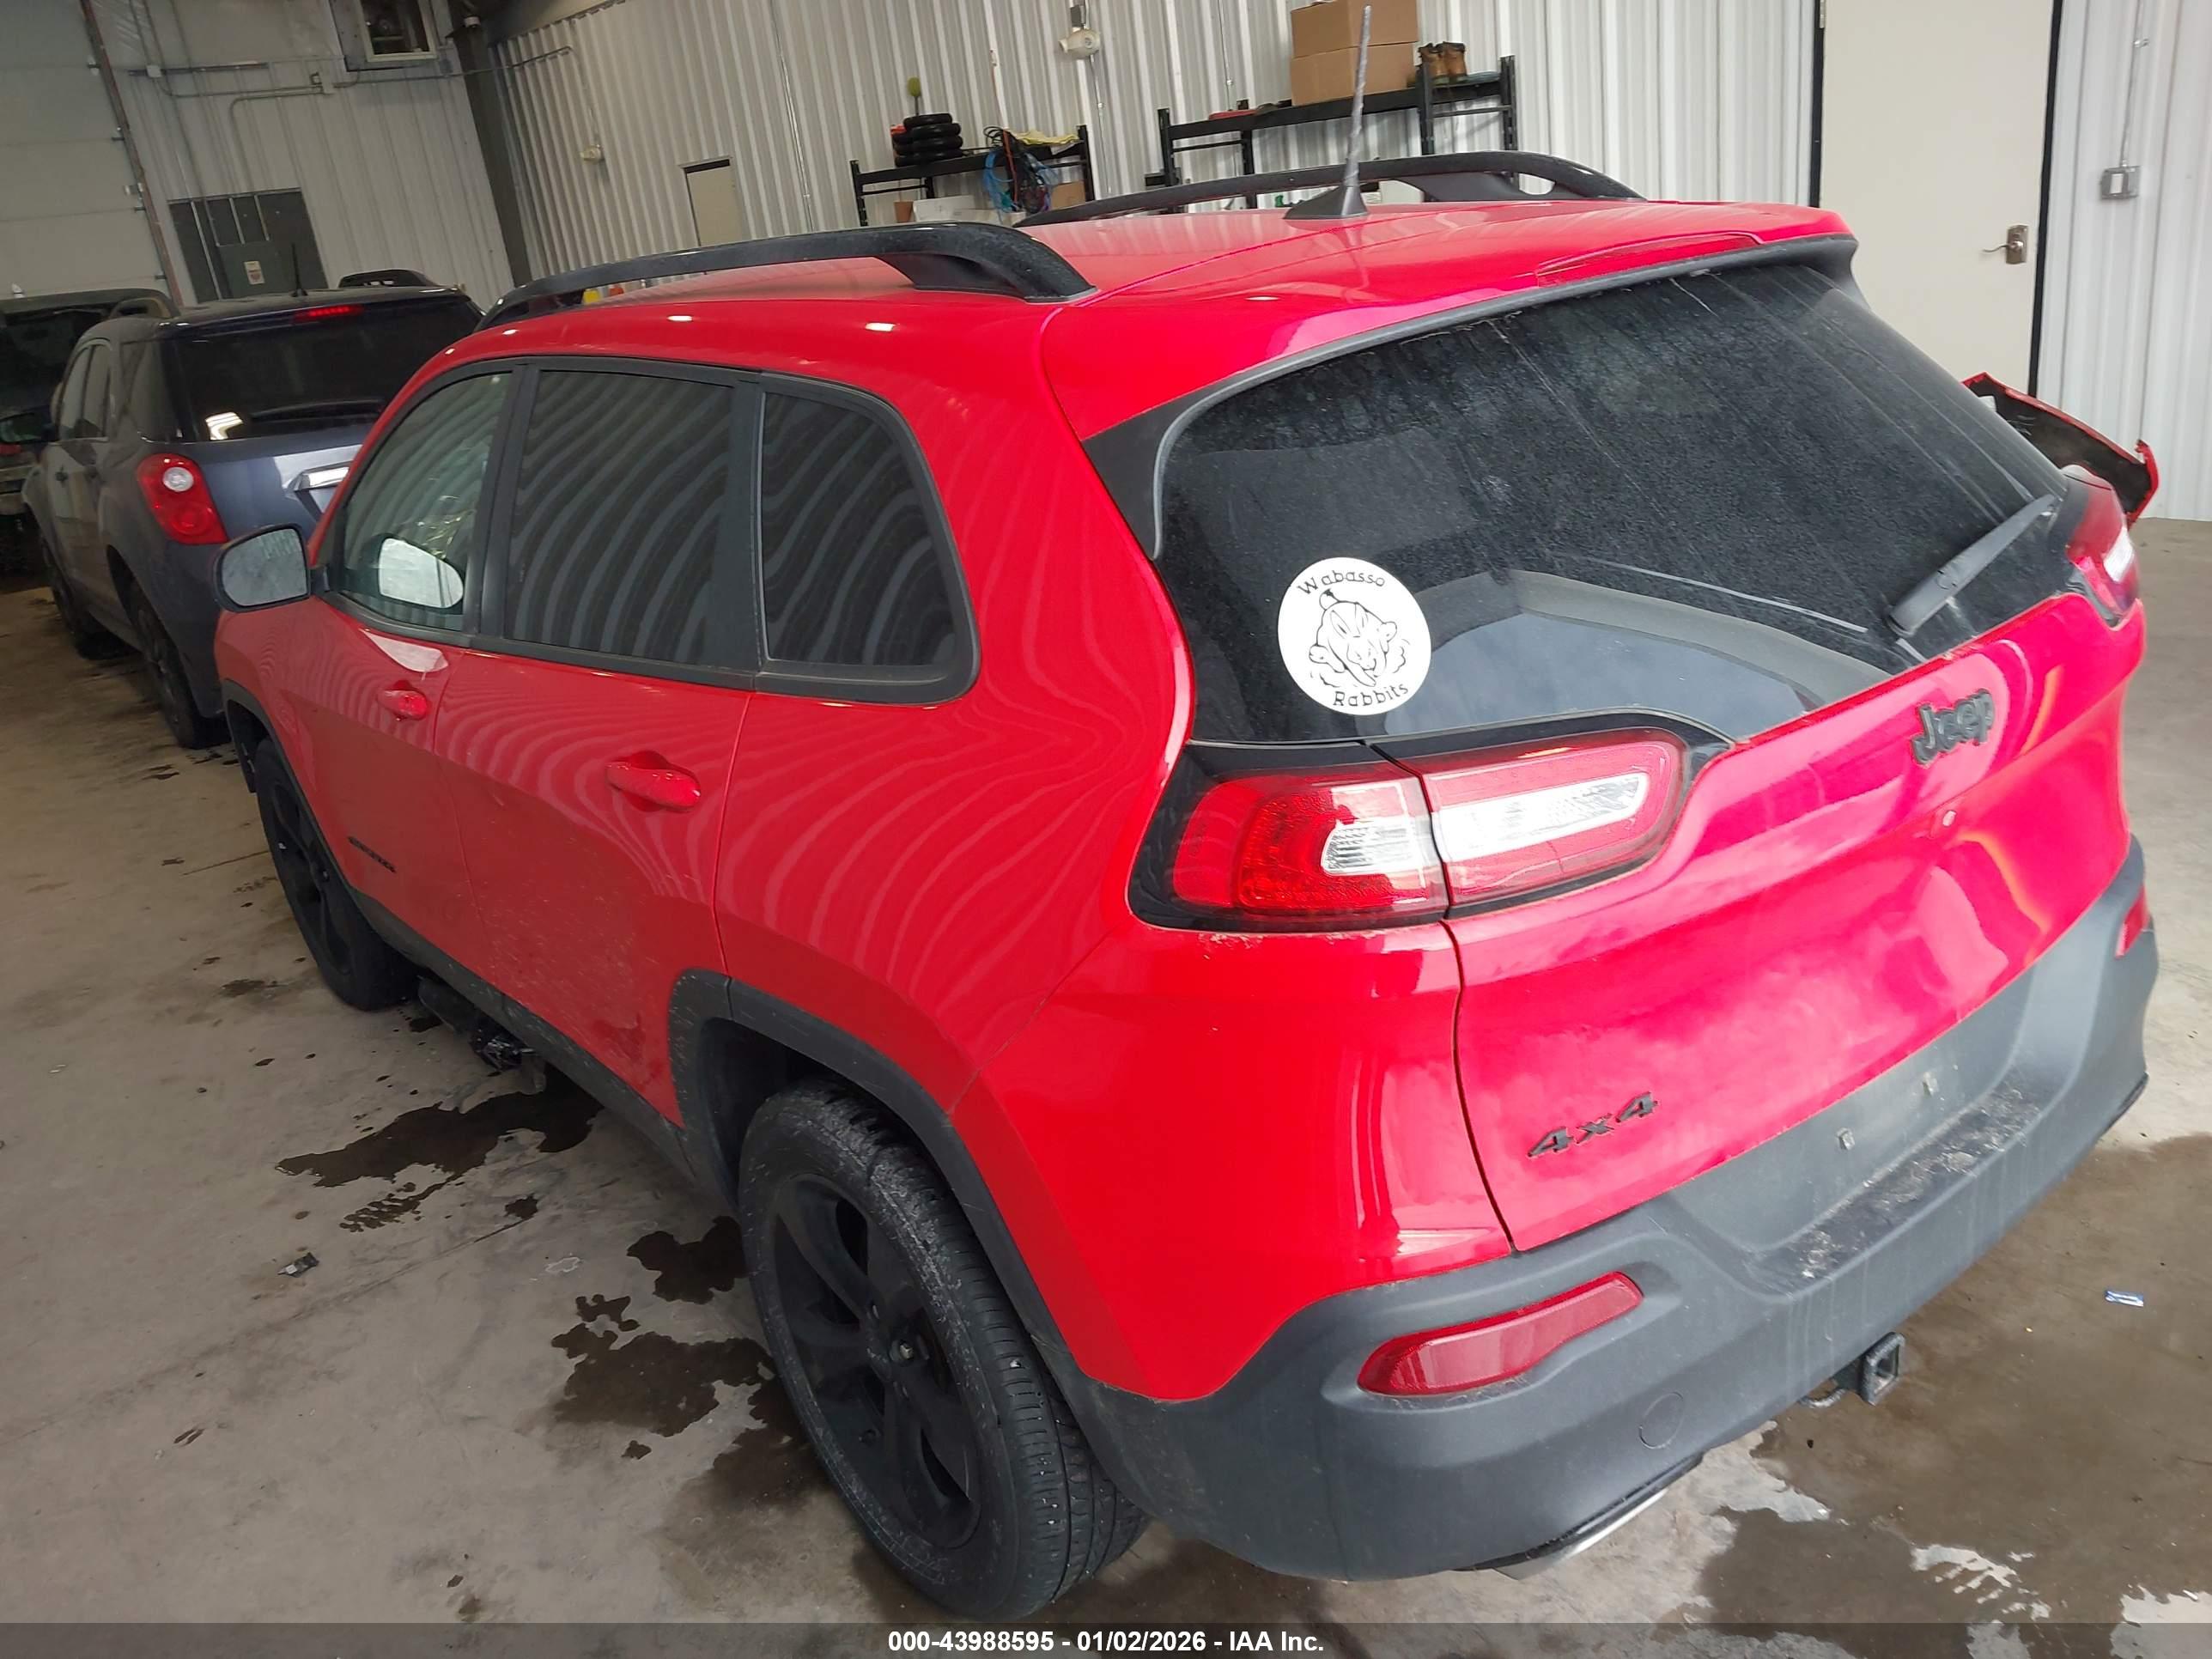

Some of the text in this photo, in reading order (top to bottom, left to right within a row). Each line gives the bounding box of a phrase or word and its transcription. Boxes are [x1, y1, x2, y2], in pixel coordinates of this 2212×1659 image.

[1297, 570, 1385, 594] Wabasso
[1333, 684, 1409, 707] Rabbits
[1911, 688, 1995, 766] Jeep
